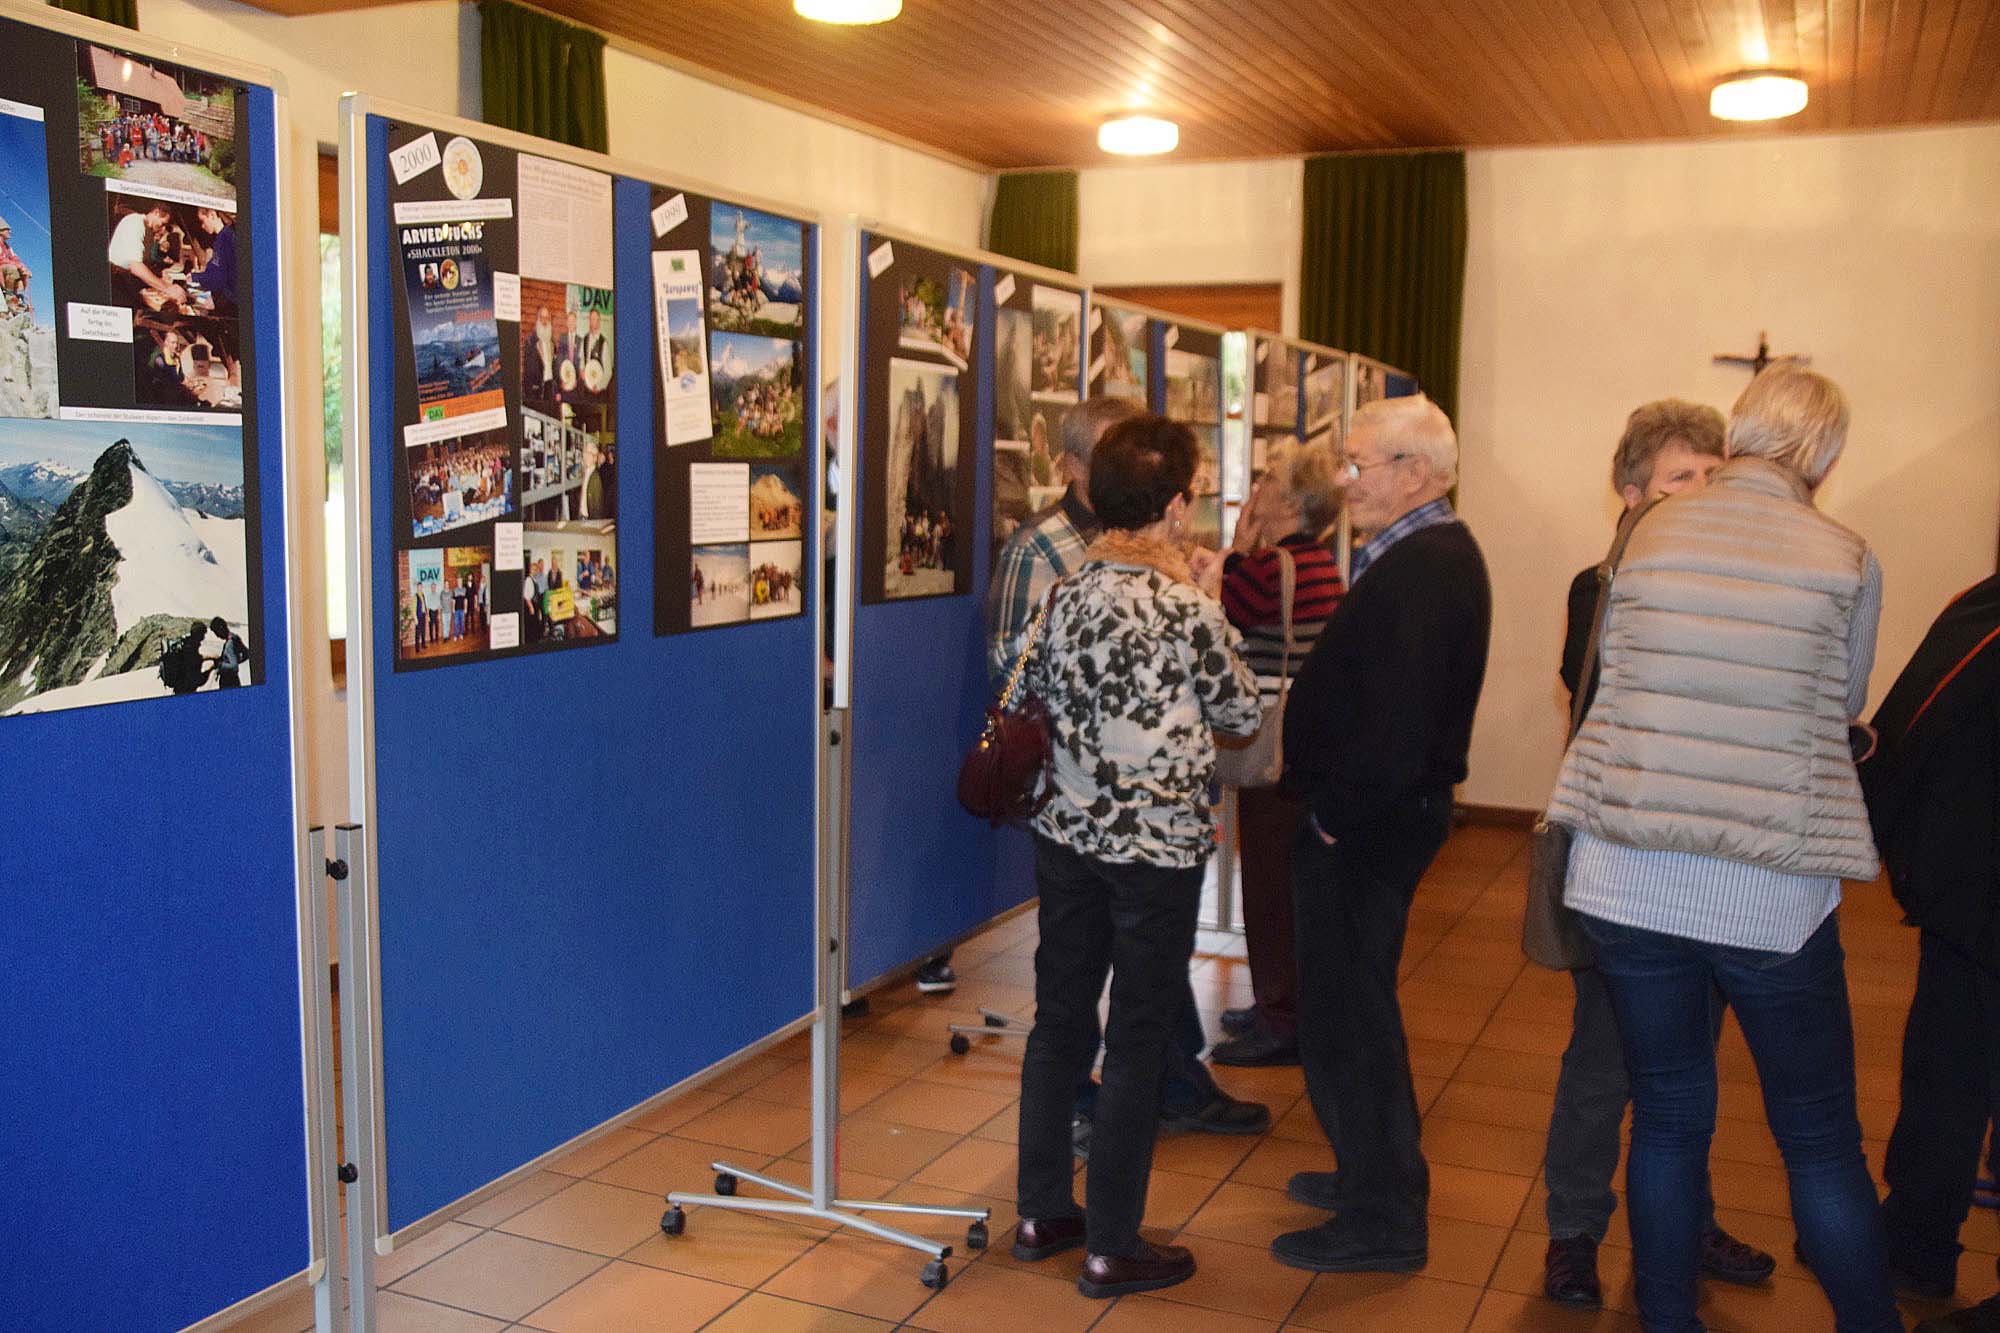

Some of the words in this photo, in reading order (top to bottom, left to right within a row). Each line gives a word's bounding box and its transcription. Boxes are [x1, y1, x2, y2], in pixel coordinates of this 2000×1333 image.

[399, 144, 432, 174] 2000
[402, 227, 443, 244] ARVED
[447, 224, 483, 241] FUCHS
[583, 286, 612, 310] DAV
[428, 408, 444, 420] DAV
[420, 568, 440, 581] DAV
